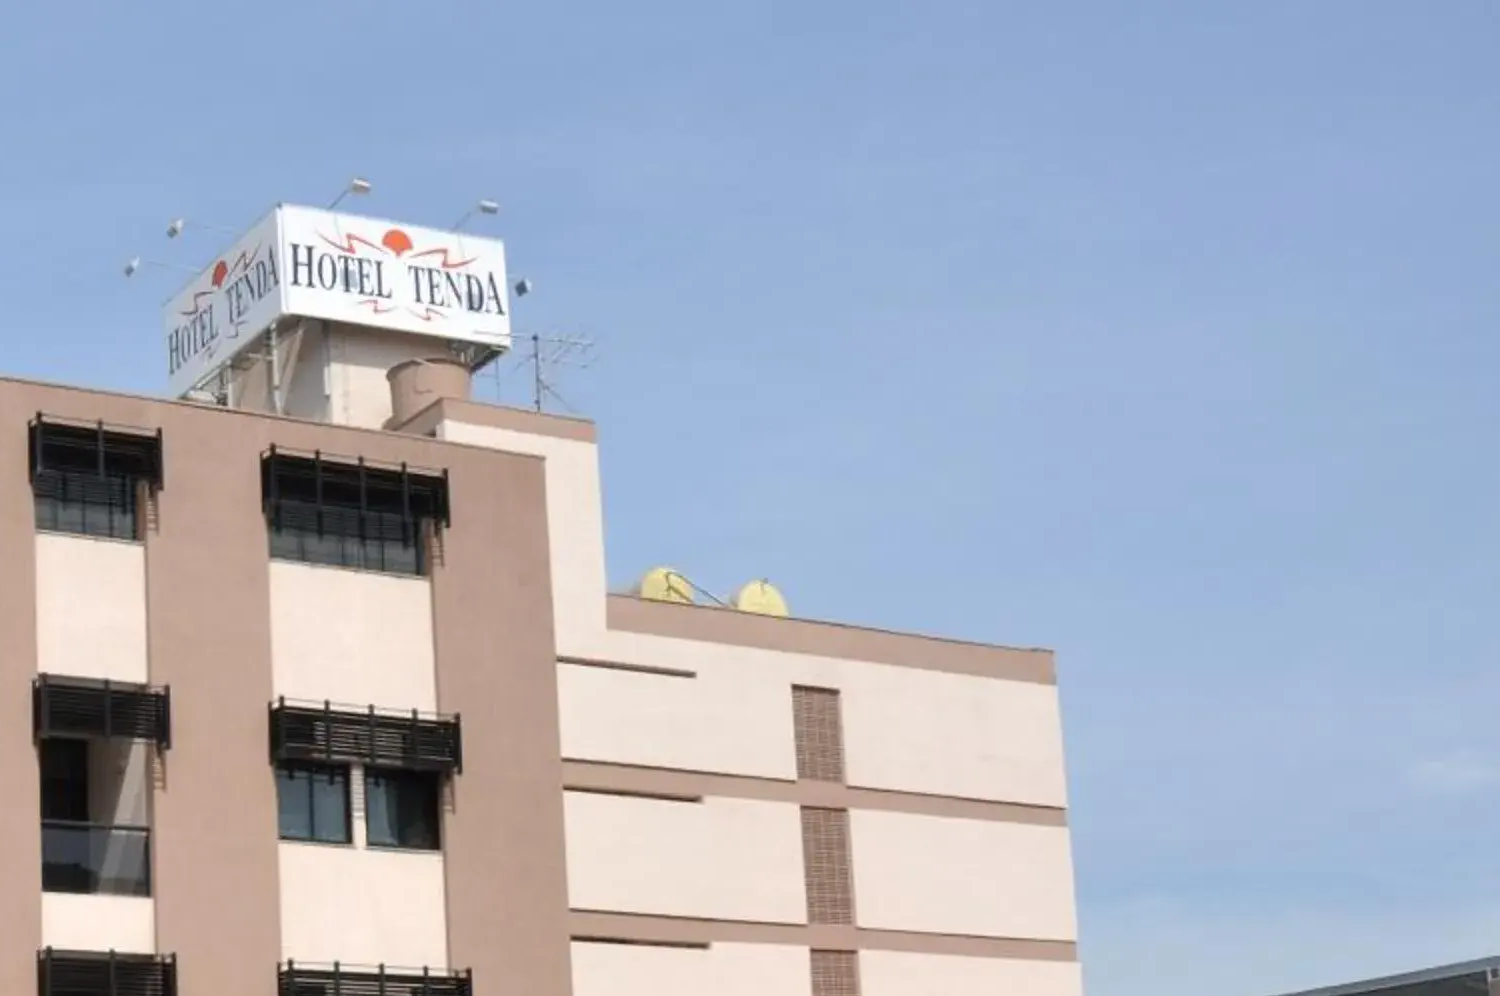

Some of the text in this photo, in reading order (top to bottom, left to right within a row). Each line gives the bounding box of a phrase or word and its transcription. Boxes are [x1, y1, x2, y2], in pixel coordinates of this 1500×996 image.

[168, 245, 280, 375] HOTEL TENDA
[289, 242, 506, 316] HOTEL TENDA
